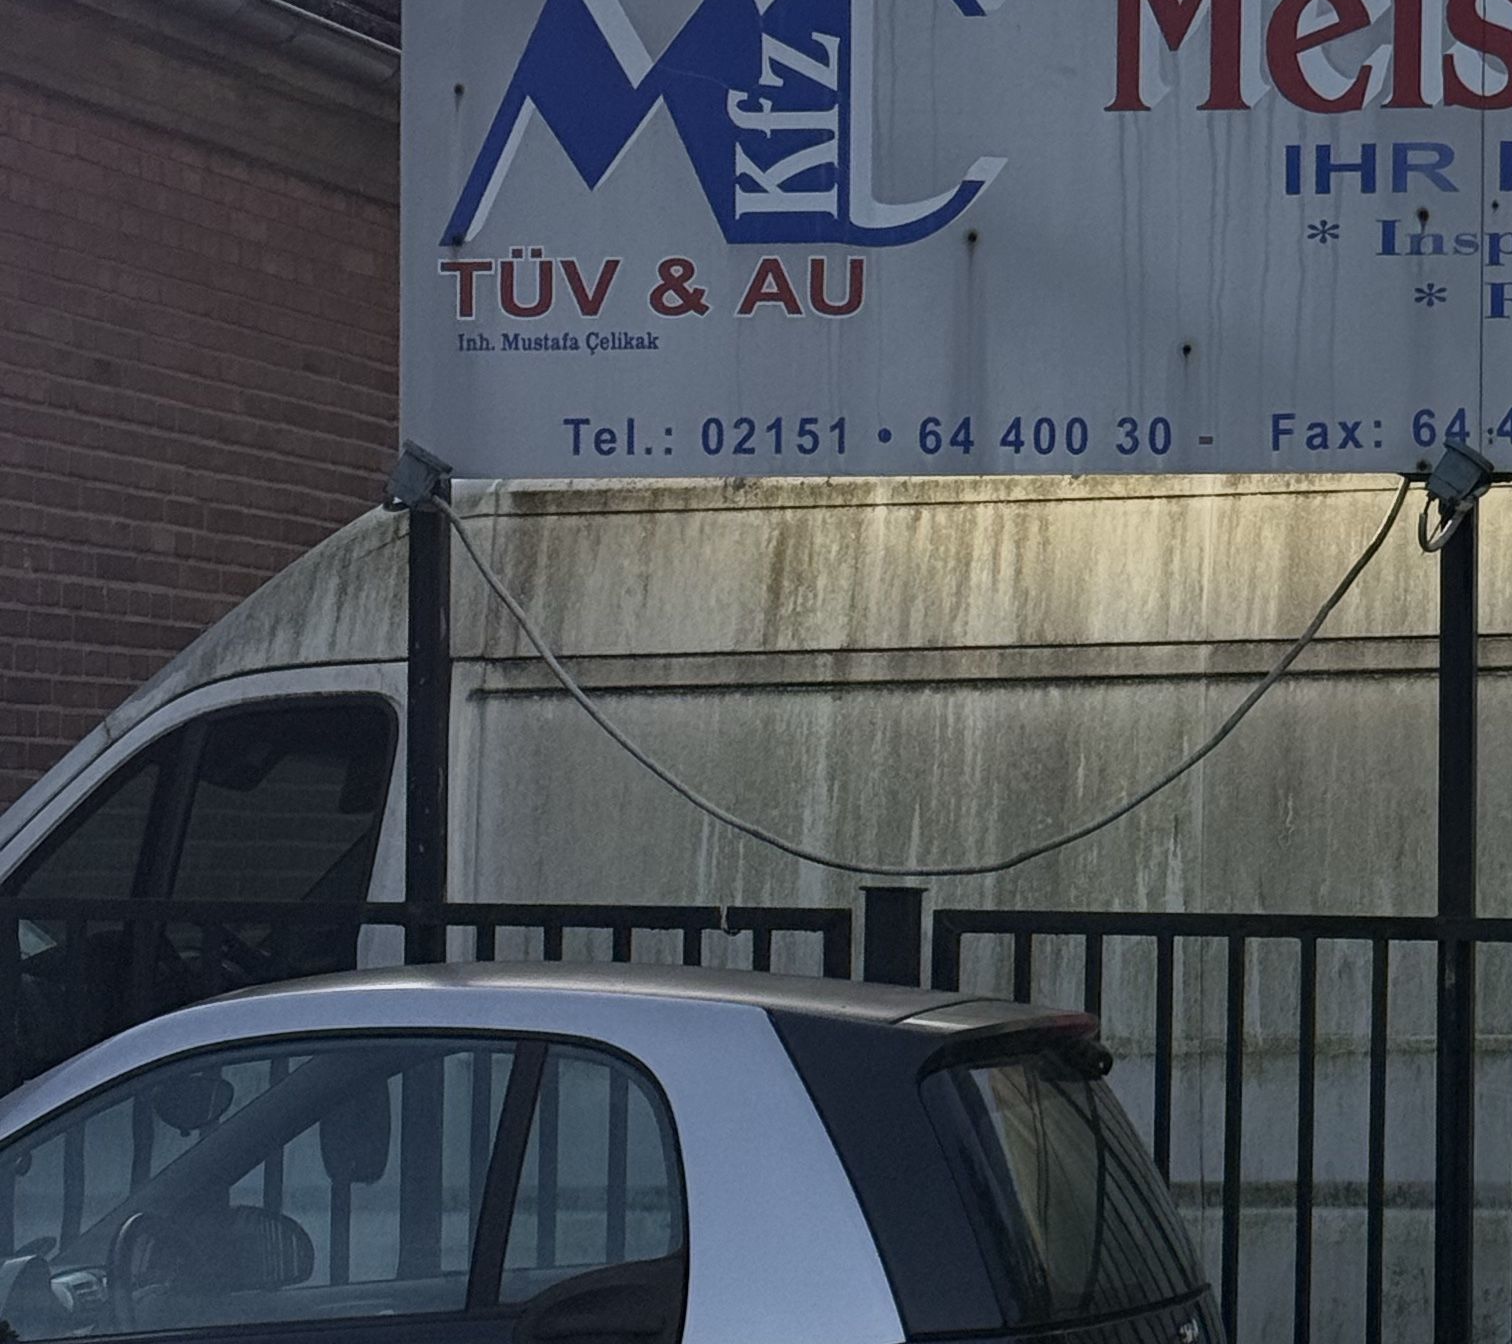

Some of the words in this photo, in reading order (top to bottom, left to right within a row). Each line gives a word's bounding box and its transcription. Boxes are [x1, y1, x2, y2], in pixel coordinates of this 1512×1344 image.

[727, 31, 841, 220] Kfz
[1284, 142, 1459, 196] IHR
[440, 248, 621, 318] TÜV
[649, 257, 711, 317] &
[737, 258, 865, 317] AU
[457, 333, 496, 352] Inh.
[501, 331, 581, 352] Mustafa
[585, 331, 660, 356] Çelikak
[562, 417, 676, 457] Tel.:
[701, 416, 846, 456] 02151
[918, 415, 975, 455] 64
[999, 416, 1089, 456] 400
[1115, 416, 1172, 456] 30
[1271, 412, 1385, 452] Fax:
[1412, 408, 1470, 447] 64
